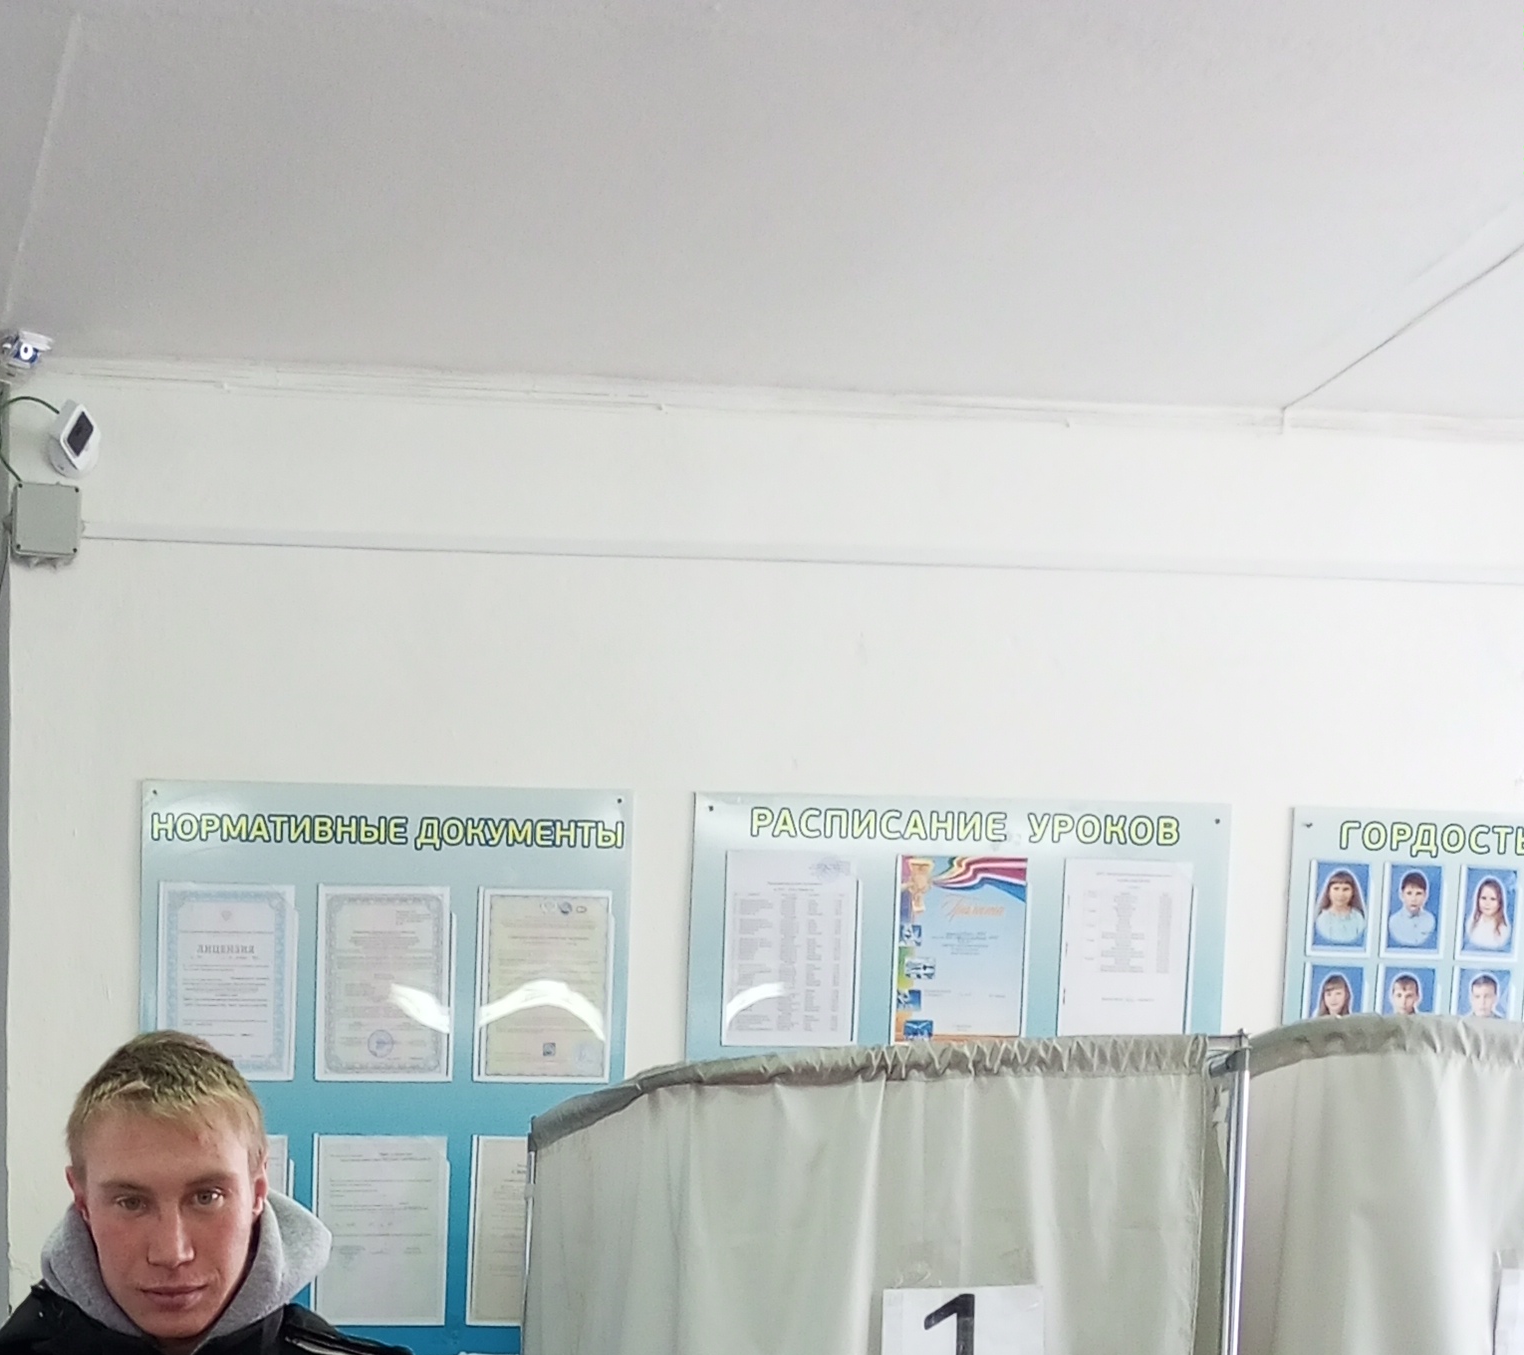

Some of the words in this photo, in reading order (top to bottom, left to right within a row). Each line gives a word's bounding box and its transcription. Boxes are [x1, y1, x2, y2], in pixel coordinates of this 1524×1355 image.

[151, 812, 408, 845] НОРМАТИВНЫЕ
[414, 816, 625, 851] ДОКУМЕНТЫ
[749, 806, 1007, 843] РАСПИСАНИЕ
[1027, 812, 1181, 847] УРОКОВ
